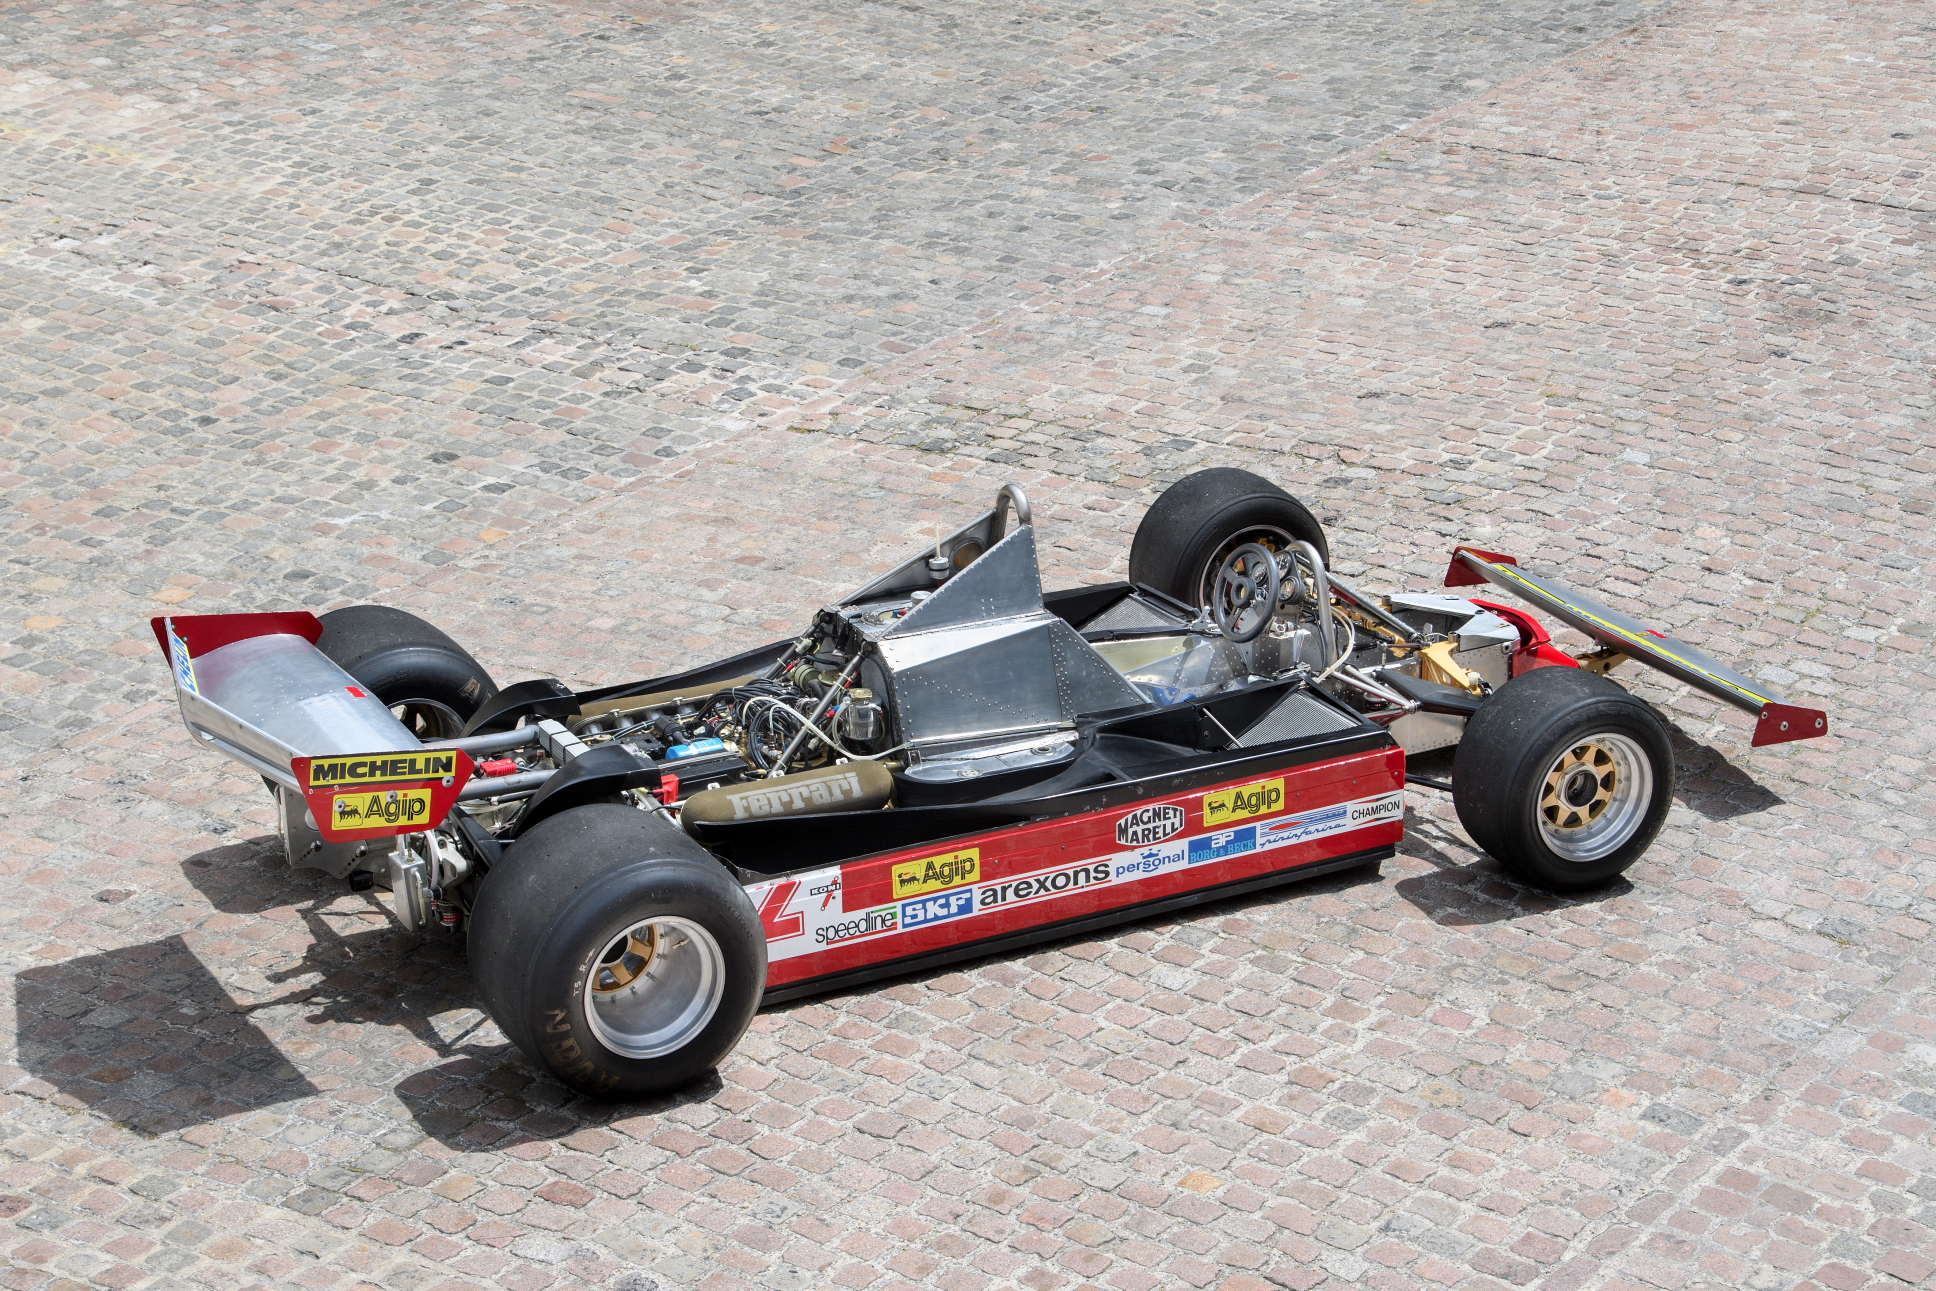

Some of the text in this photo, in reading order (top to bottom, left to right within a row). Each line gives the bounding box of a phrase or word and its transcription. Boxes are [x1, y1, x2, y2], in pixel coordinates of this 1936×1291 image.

[312, 755, 453, 783] MICHELIN
[365, 793, 426, 824] Agip
[726, 771, 863, 821] Ferrari
[1231, 785, 1281, 815] Agip
[1351, 799, 1400, 821] CHAMPION
[1117, 806, 1184, 837] MAGNETI
[1117, 817, 1184, 844] MARELLI
[1259, 823, 1347, 848] pininfarina
[1116, 850, 1185, 878] personal
[1190, 839, 1255, 863] BORG & BECK
[922, 854, 975, 886] Agip
[979, 861, 1110, 907] arexons
[811, 883, 841, 895] KONI
[904, 892, 971, 927] SKF
[815, 910, 895, 946] speedline
